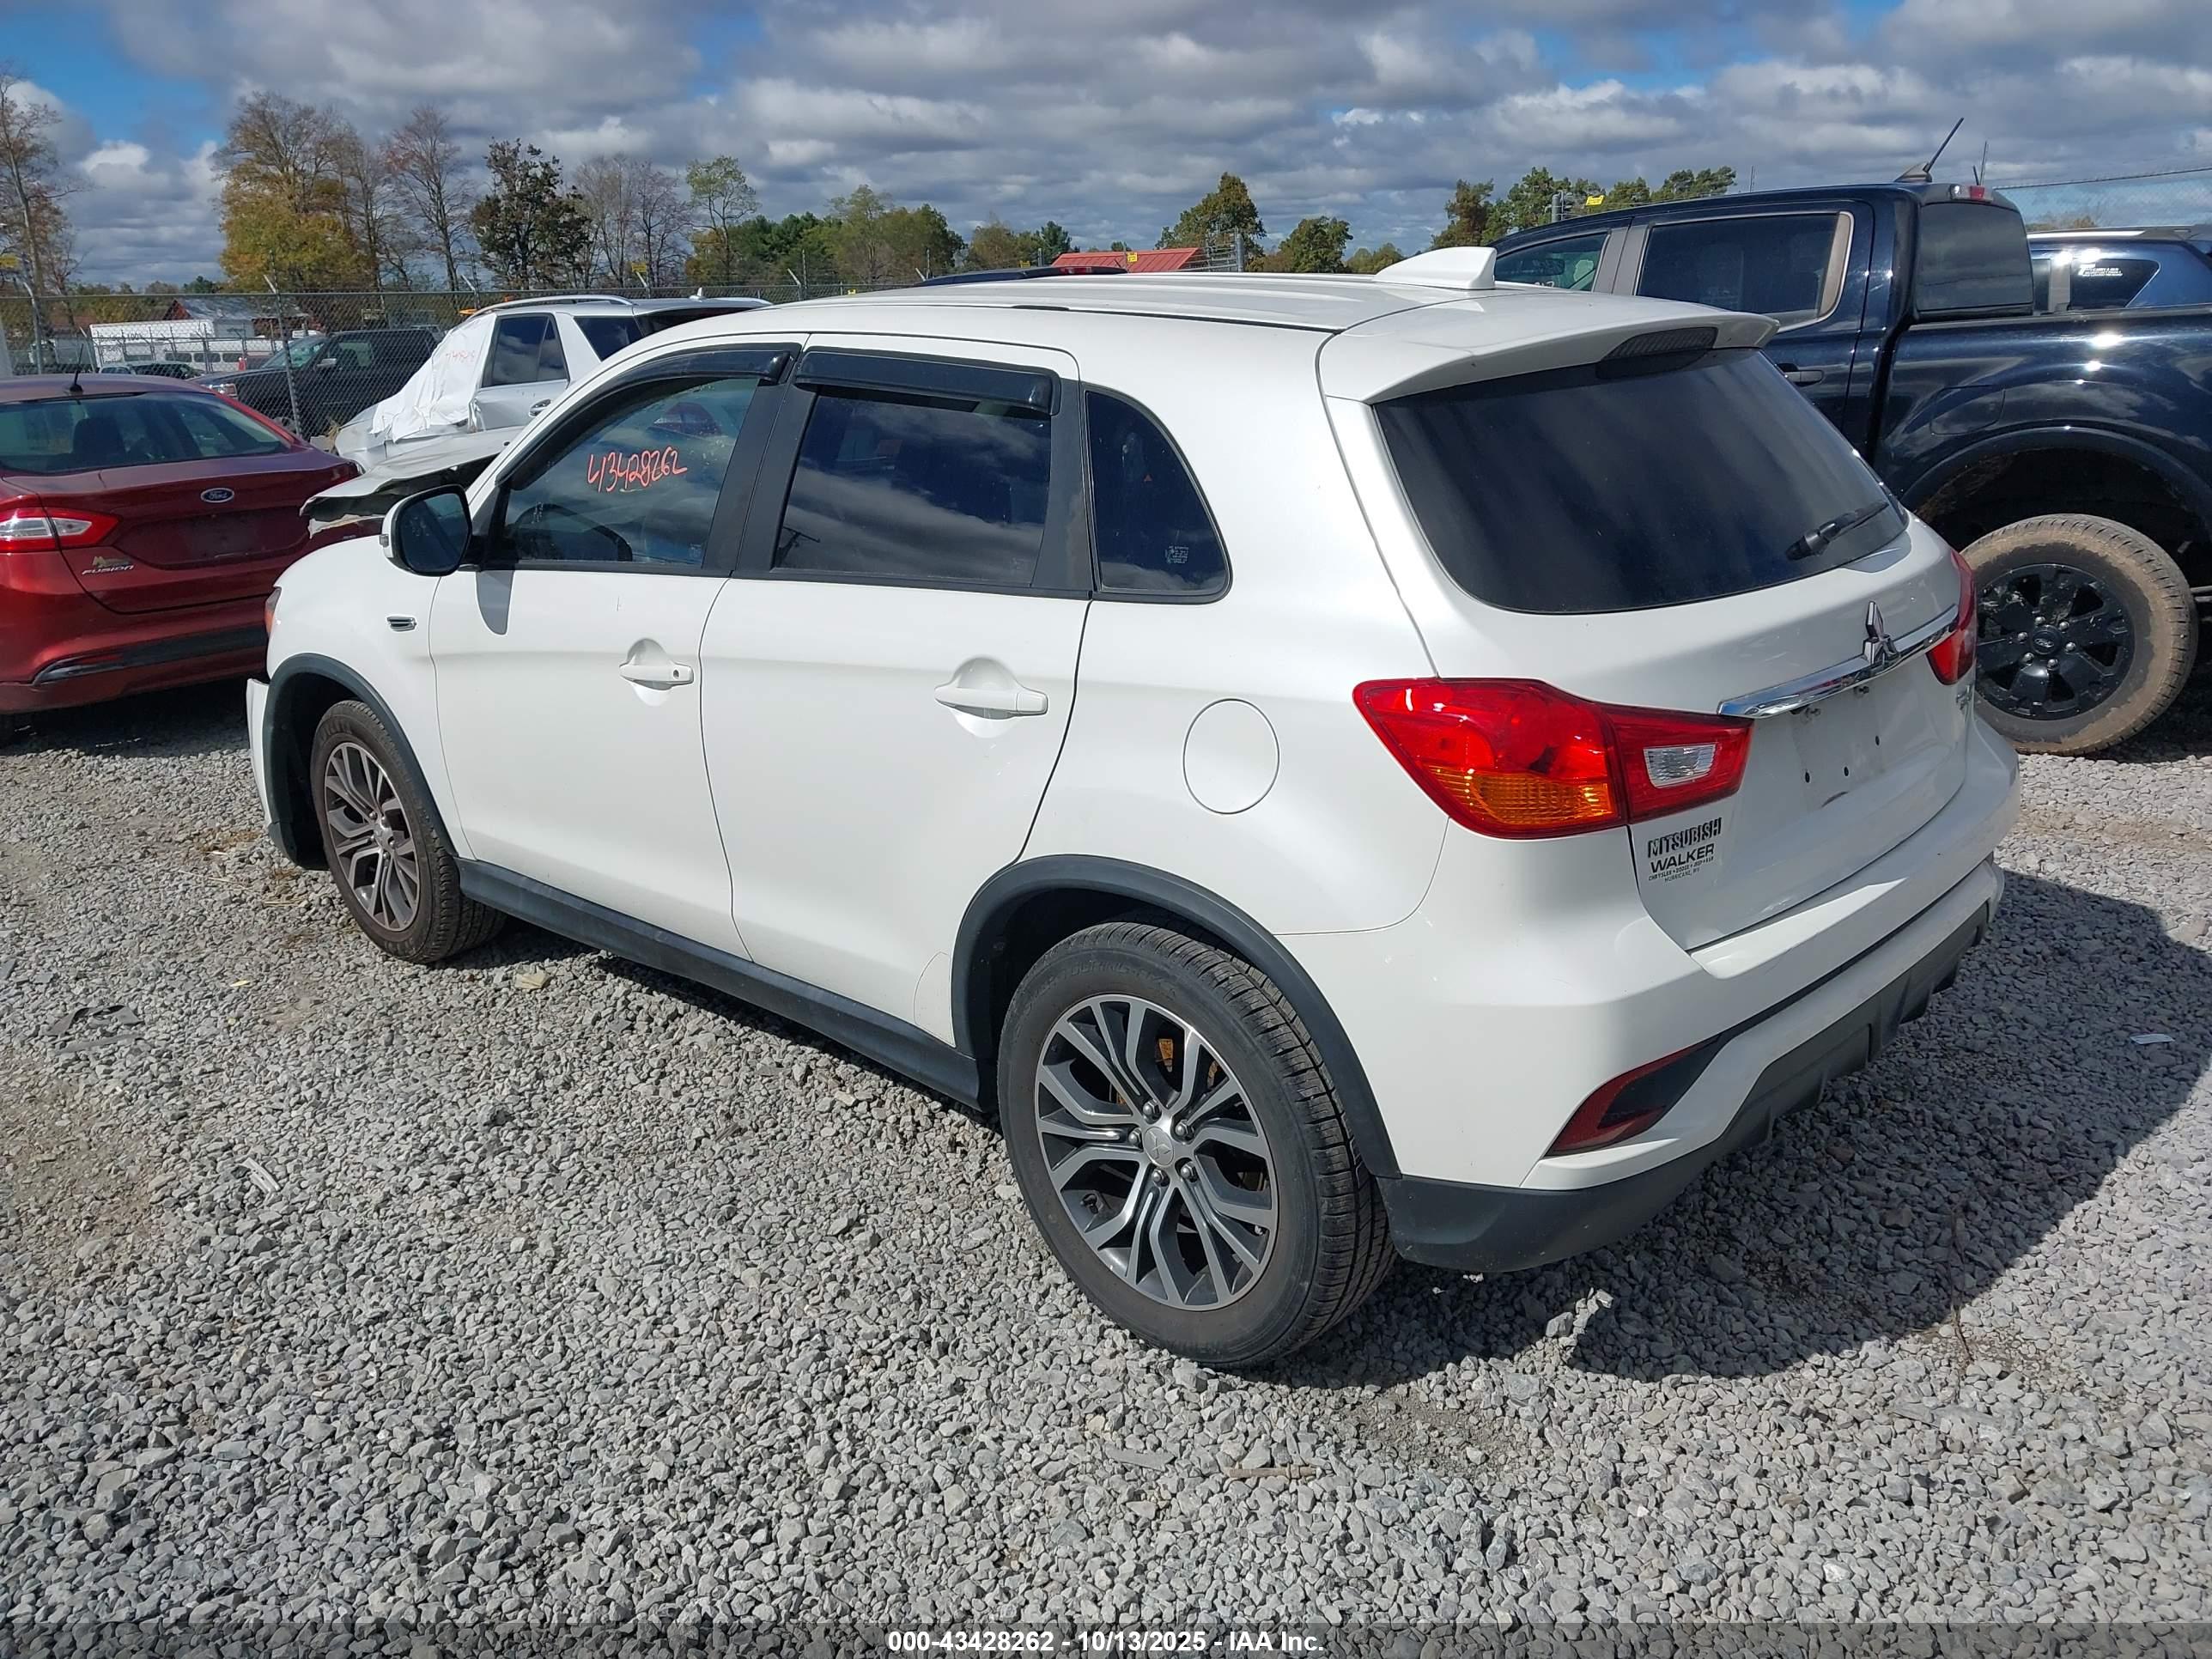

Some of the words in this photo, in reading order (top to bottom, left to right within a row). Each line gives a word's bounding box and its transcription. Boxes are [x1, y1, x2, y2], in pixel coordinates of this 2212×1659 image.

[587, 446, 688, 494] 43428262
[82, 565, 134, 575] FUSION
[1650, 843, 1715, 873] WALKER
